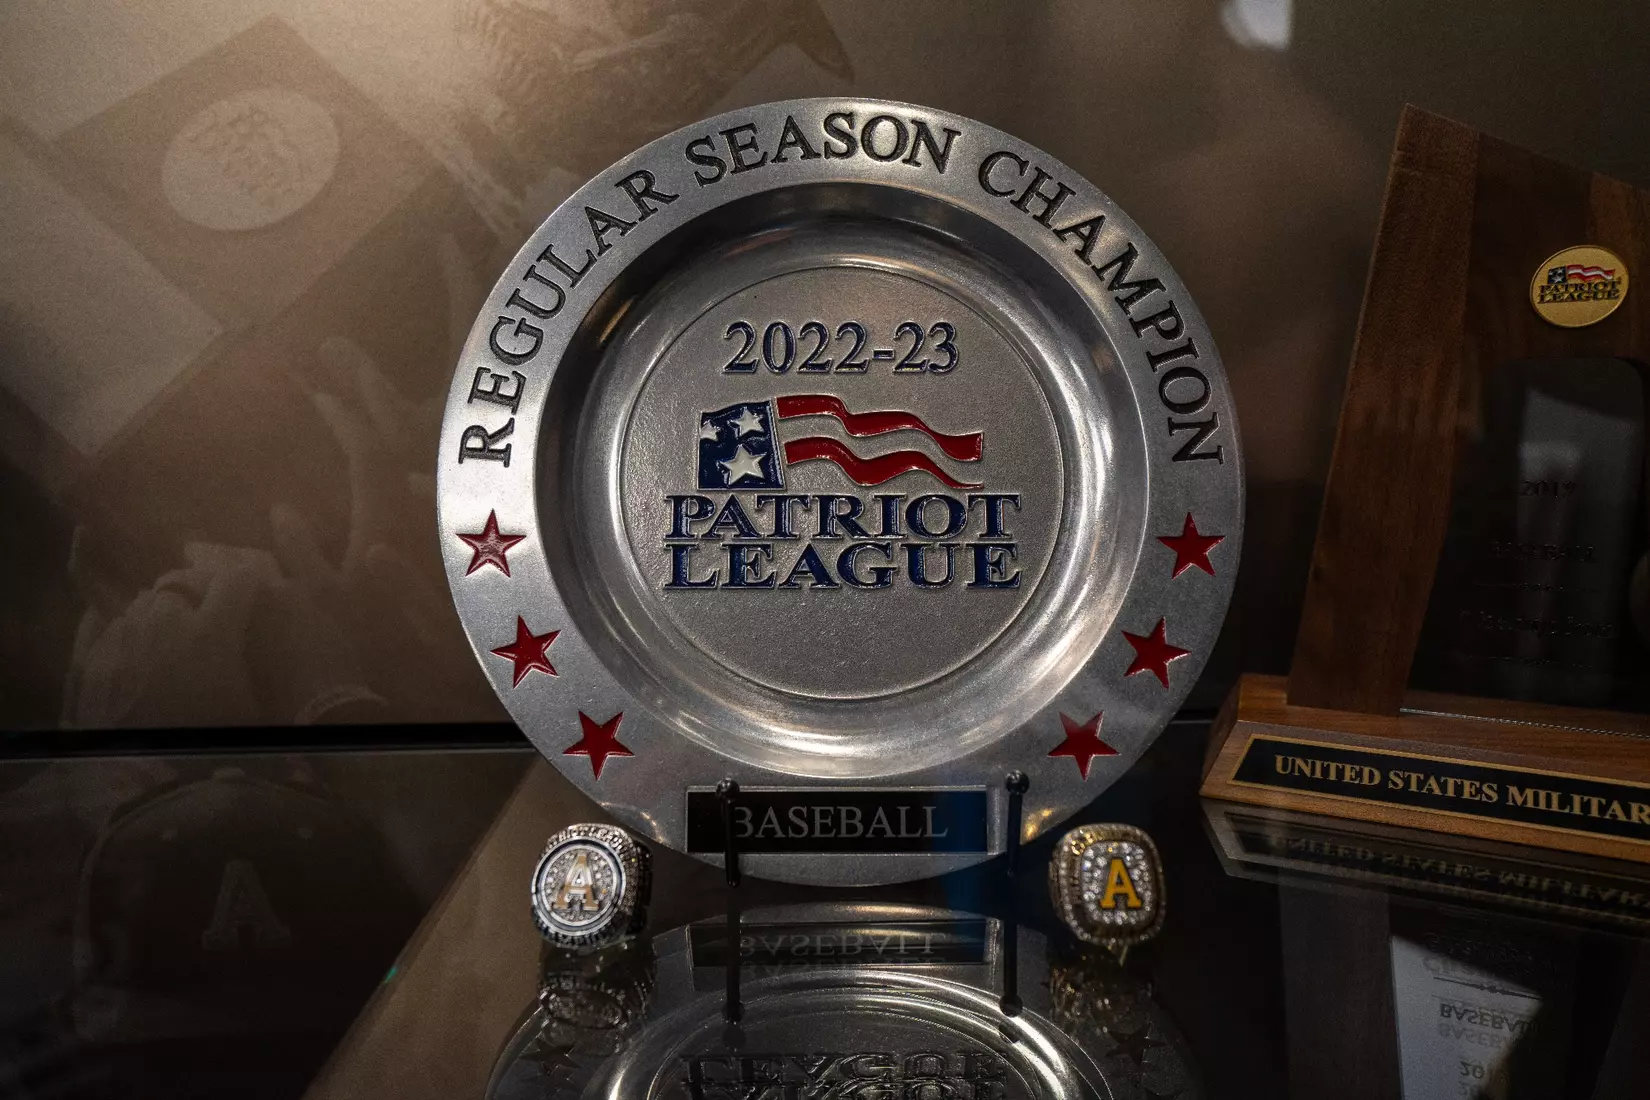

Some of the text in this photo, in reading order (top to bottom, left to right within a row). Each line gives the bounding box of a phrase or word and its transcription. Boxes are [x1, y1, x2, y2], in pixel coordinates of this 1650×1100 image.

[458, 112, 1224, 467] REGULAR SEASON CHAMPION
[1537, 289, 1621, 304] LEAGUE
[1539, 279, 1621, 296] PATRIOT
[722, 320, 960, 374] 2022-23
[665, 493, 1021, 540] PATRIOT
[664, 542, 1021, 590] LEAGUE
[1274, 754, 1650, 826] UNITED STATES MILITAR
[732, 805, 949, 839] BASEBALL
[552, 853, 601, 911] A
[1100, 858, 1143, 910] A
